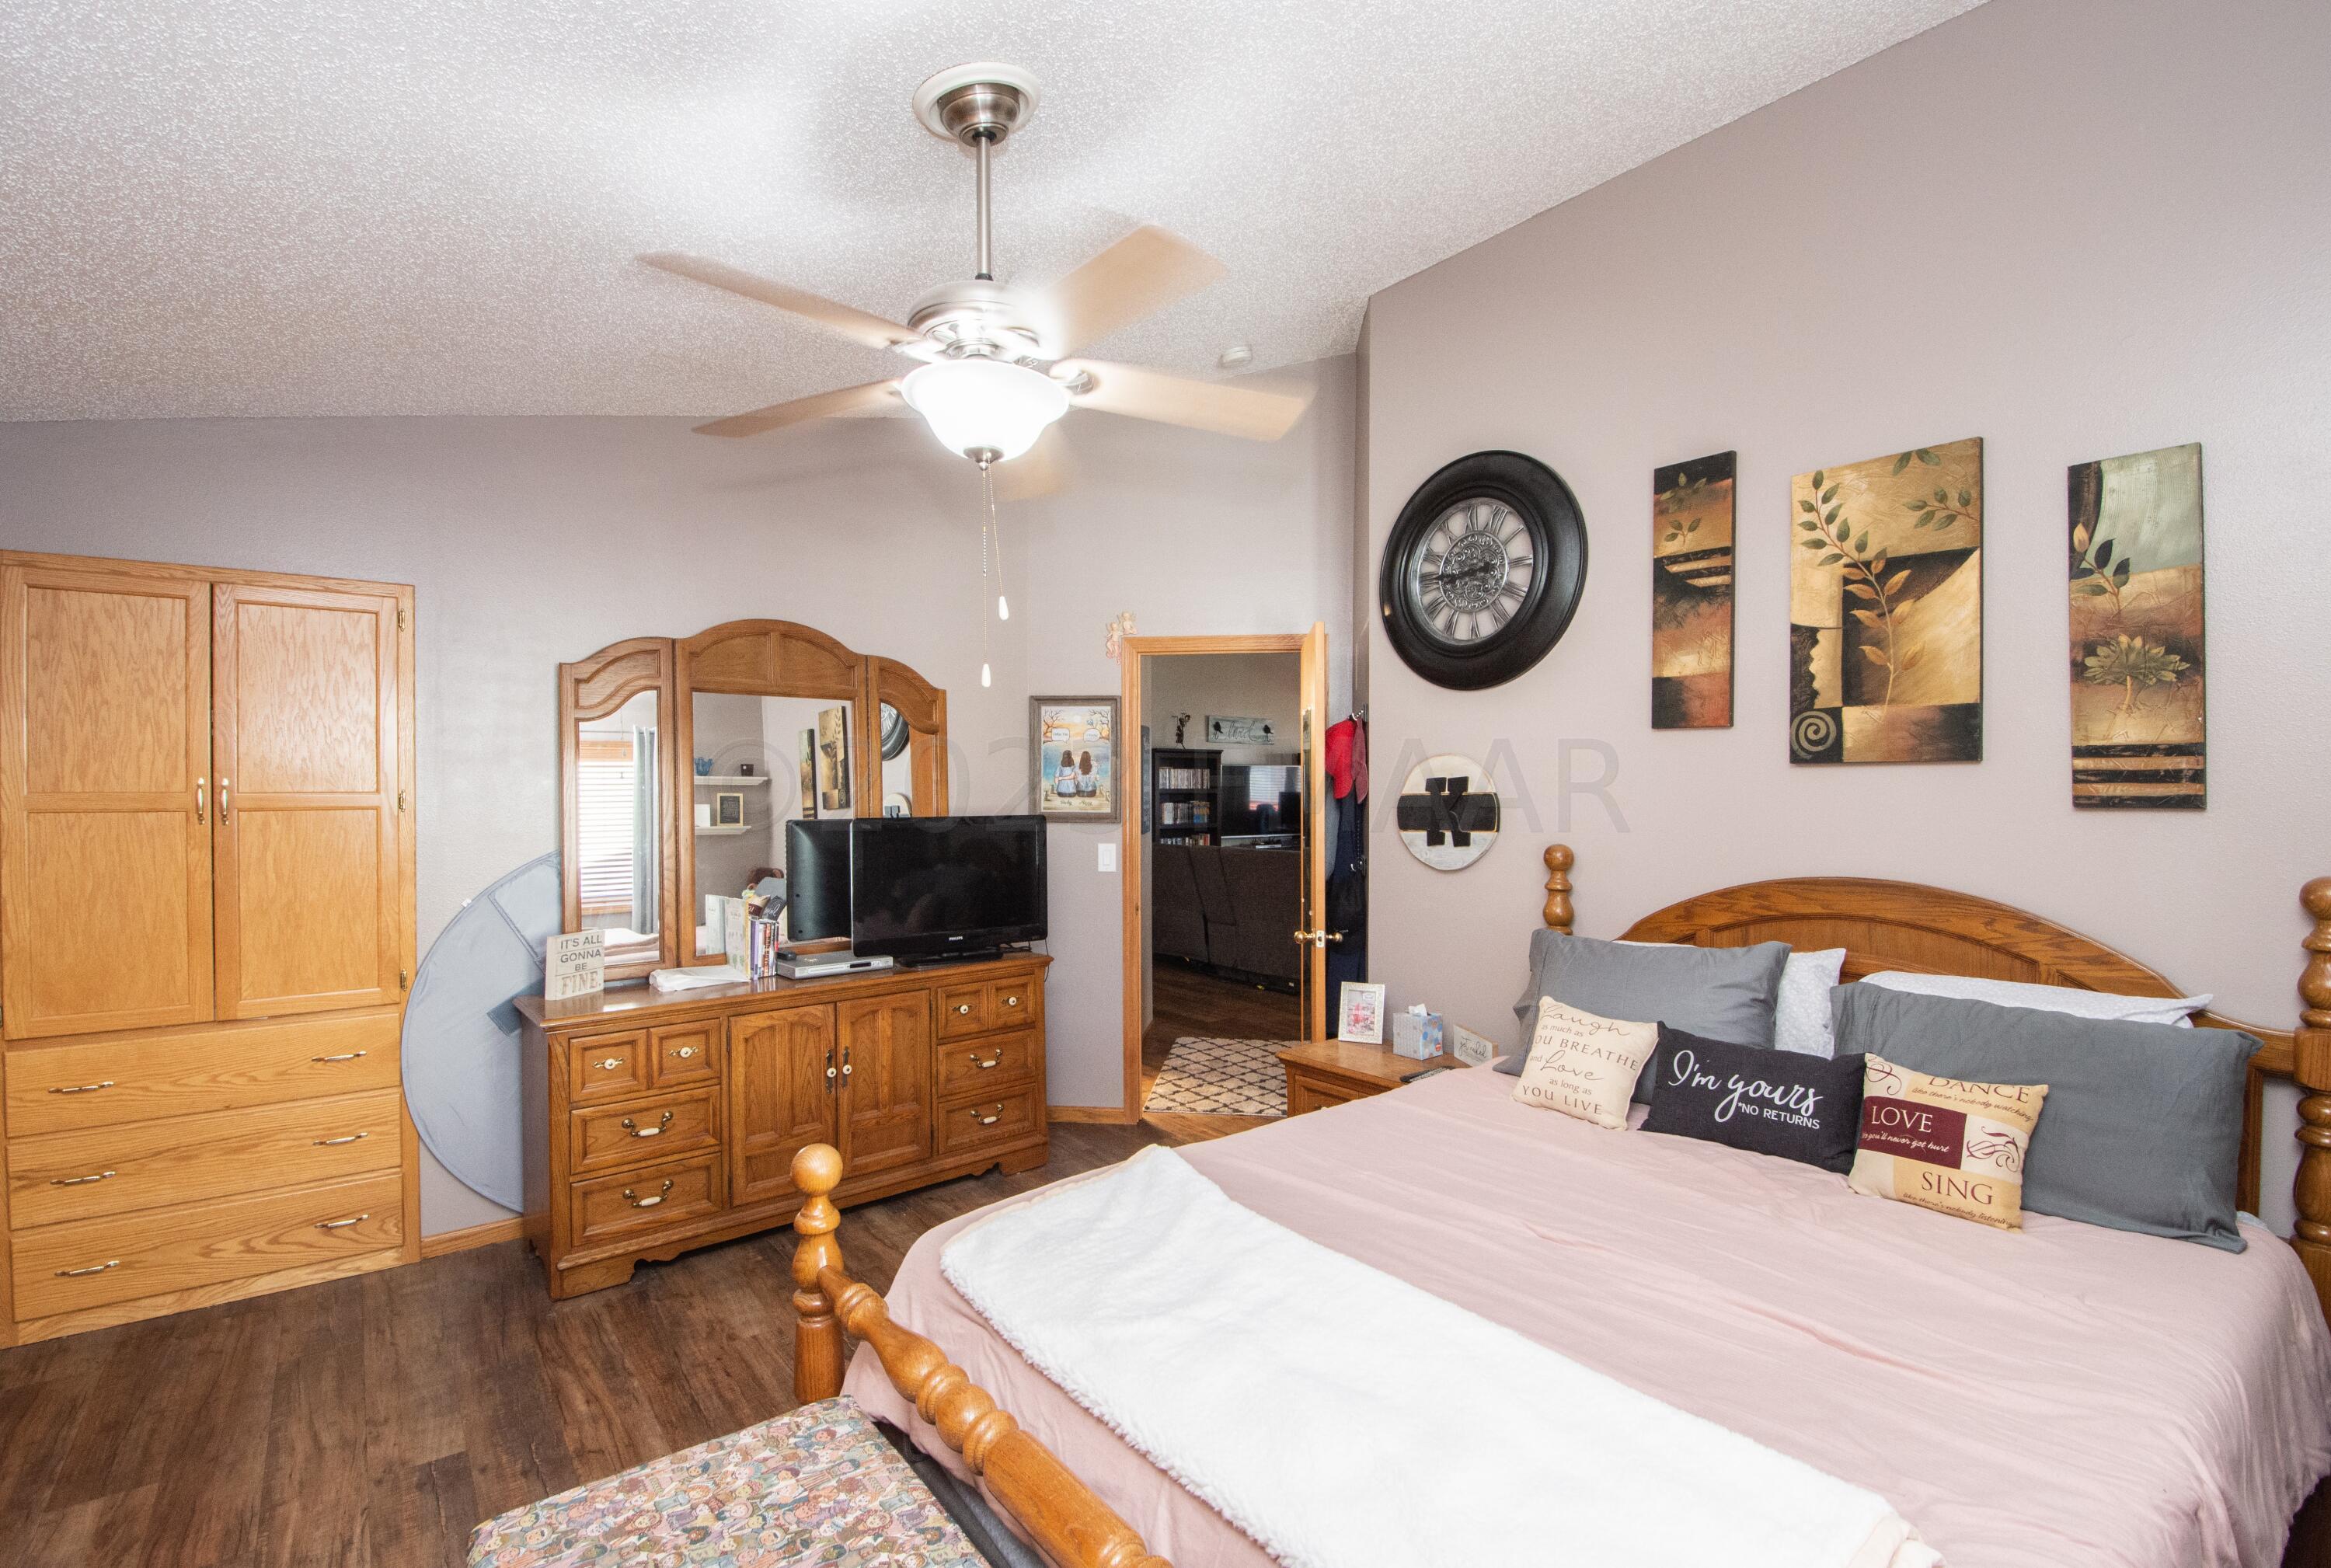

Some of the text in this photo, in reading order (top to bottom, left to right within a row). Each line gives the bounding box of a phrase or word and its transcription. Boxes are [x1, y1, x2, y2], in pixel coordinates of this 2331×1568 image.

[1425, 775, 1472, 848] K
[560, 935, 602, 950] IT'S ALL
[560, 950, 601, 963] GONNA
[575, 963, 587, 971] BE
[561, 971, 601, 995] FINE.
[1540, 1004, 1630, 1037] Laugh
[1549, 1025, 1572, 1035] much
[1529, 1049, 1605, 1081] and Love
[1535, 1035, 1639, 1071] OU BREATHE
[1549, 1077, 1593, 1096] as long as
[1667, 1050, 1824, 1123] I'm yours
[1929, 1077, 2031, 1104] DANCE
[1522, 1085, 1604, 1115] YOU LIVE
[1959, 1097, 1993, 1110] nobody
[1994, 1103, 2034, 1122] watching
[1763, 1108, 1821, 1130] RETURNS
[1871, 1106, 1933, 1134] LOVE
[1887, 1135, 1911, 1145] never
[1928, 1141, 1950, 1153] hurt
[1922, 1171, 1993, 1205] SING
[1946, 1205, 1977, 1219] nobody
